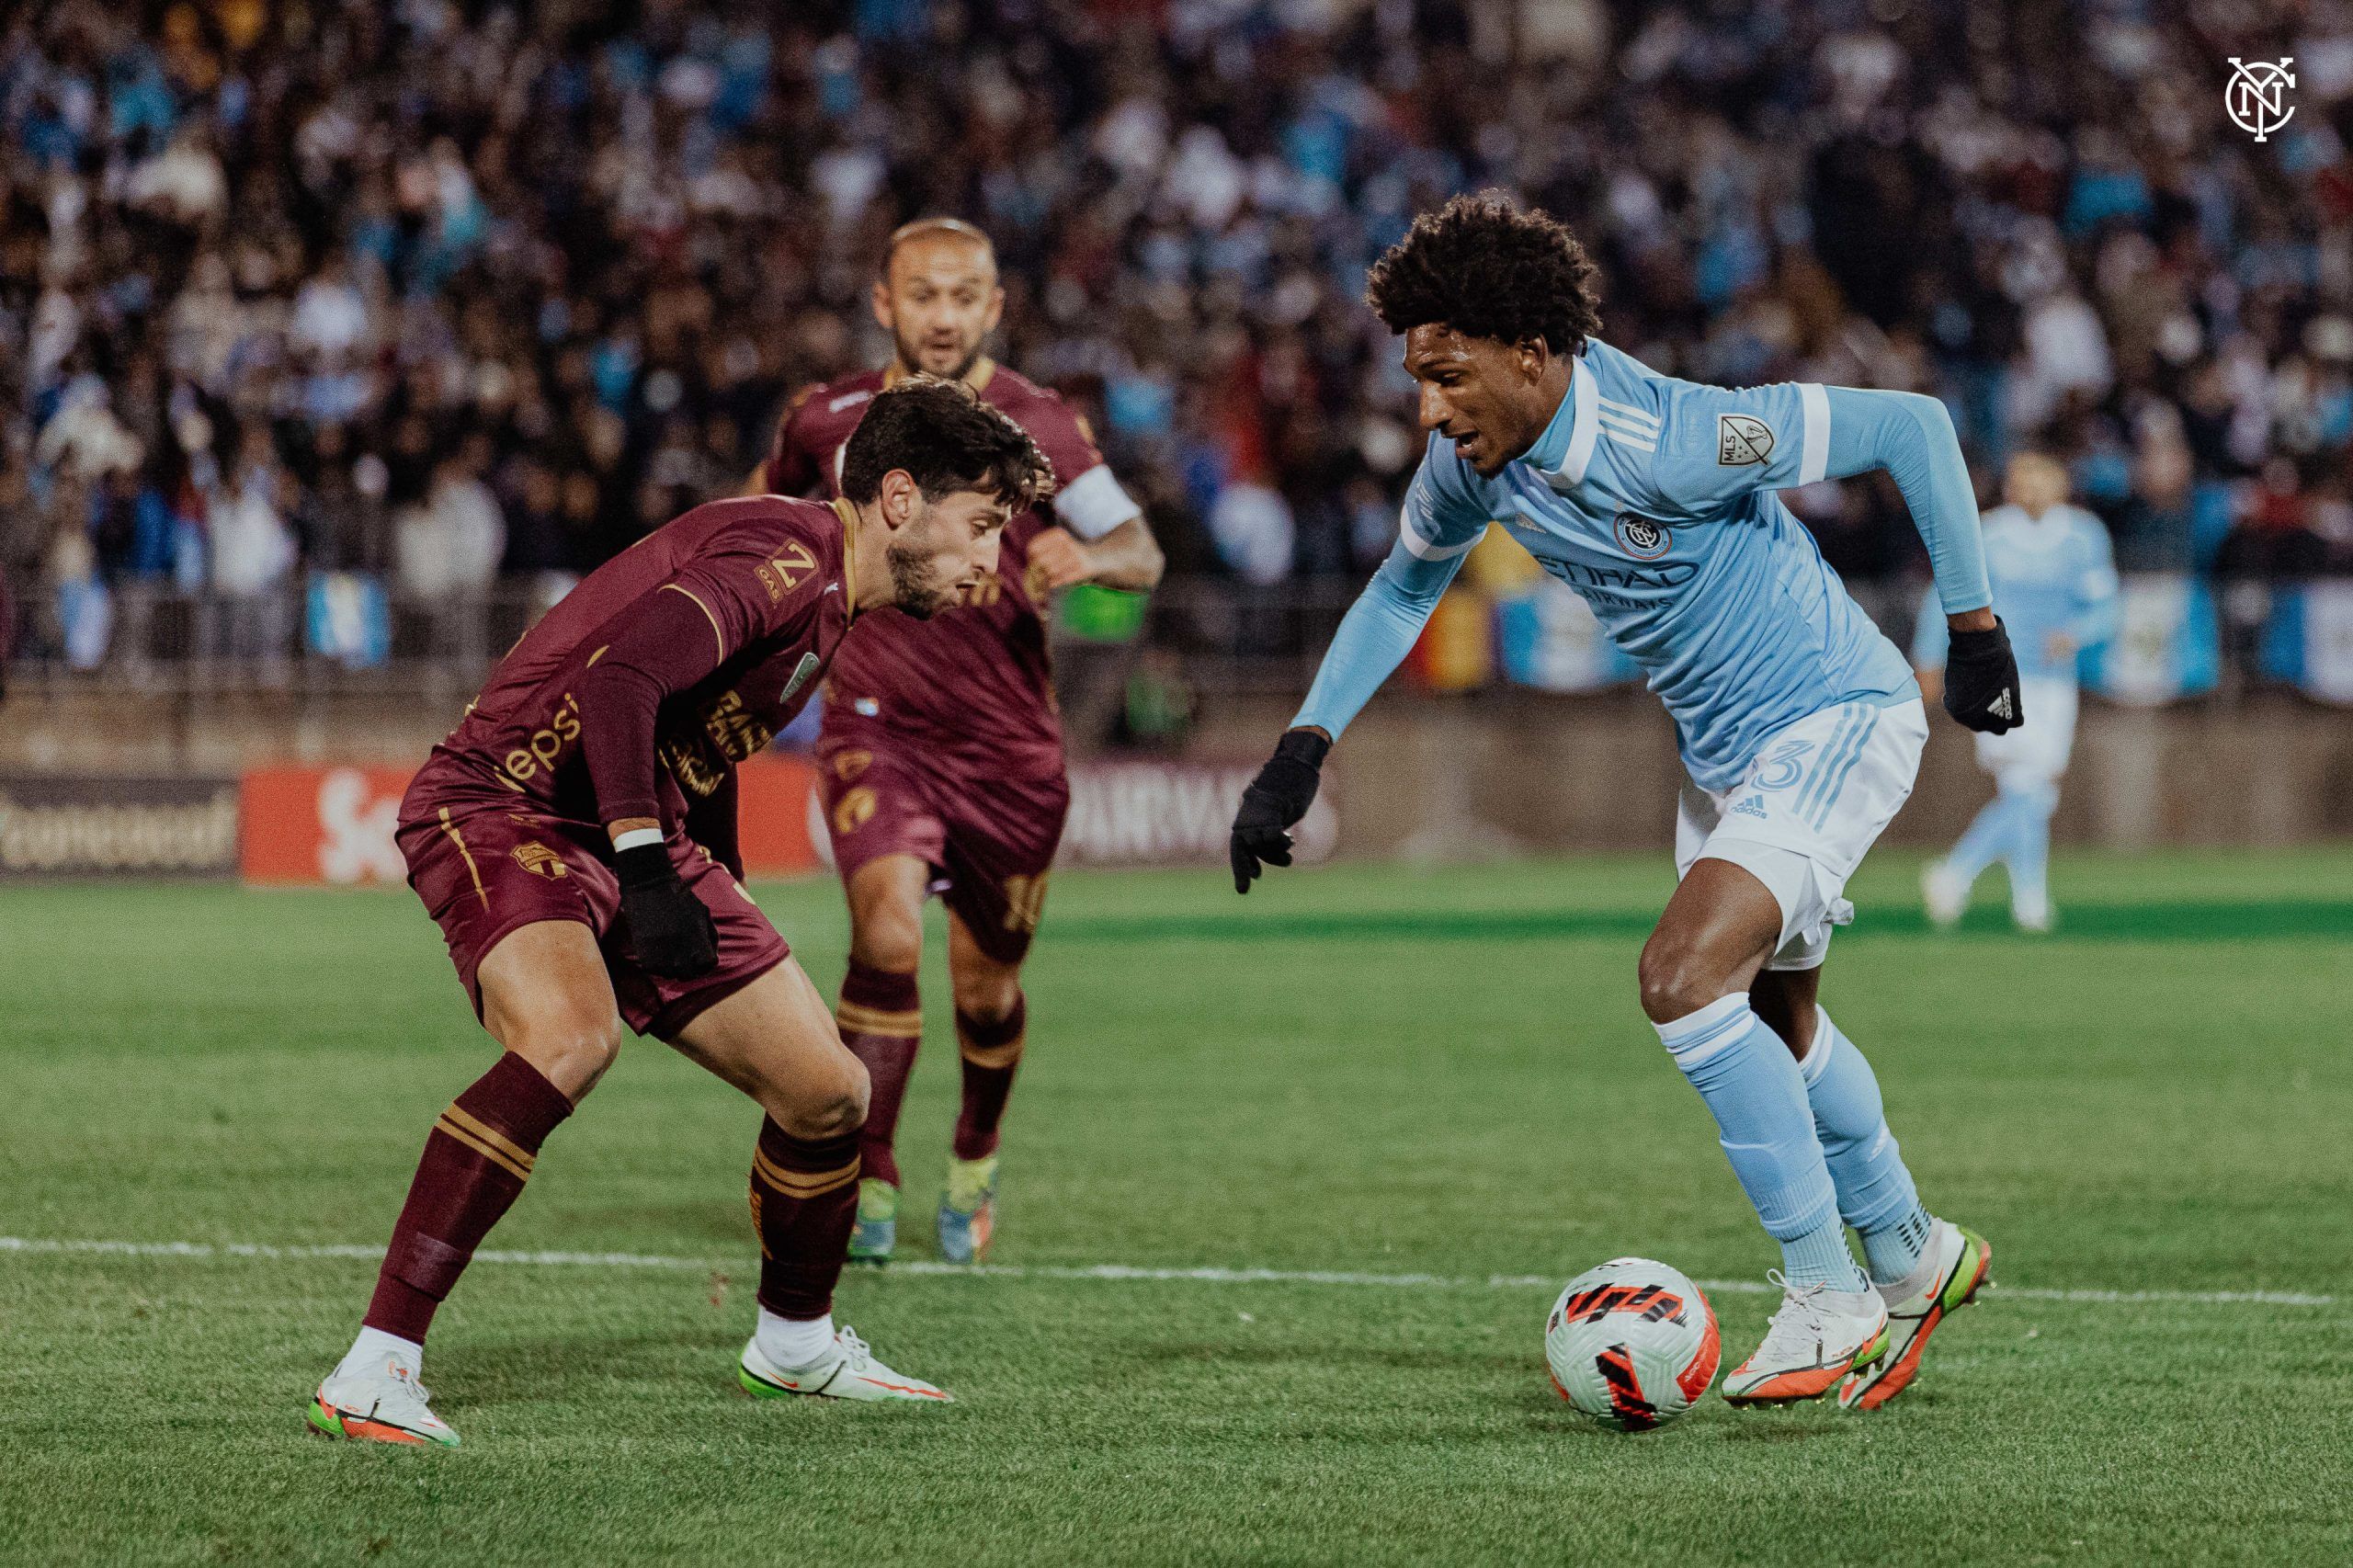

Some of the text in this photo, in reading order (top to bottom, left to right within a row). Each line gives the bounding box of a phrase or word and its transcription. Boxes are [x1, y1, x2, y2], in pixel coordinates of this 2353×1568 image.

[1723, 435, 1736, 461] MLS
[758, 568, 779, 600] GAS
[1531, 553, 1700, 588] ETIHAD
[1750, 740, 1817, 793] 3
[1730, 802, 1768, 820] adidas
